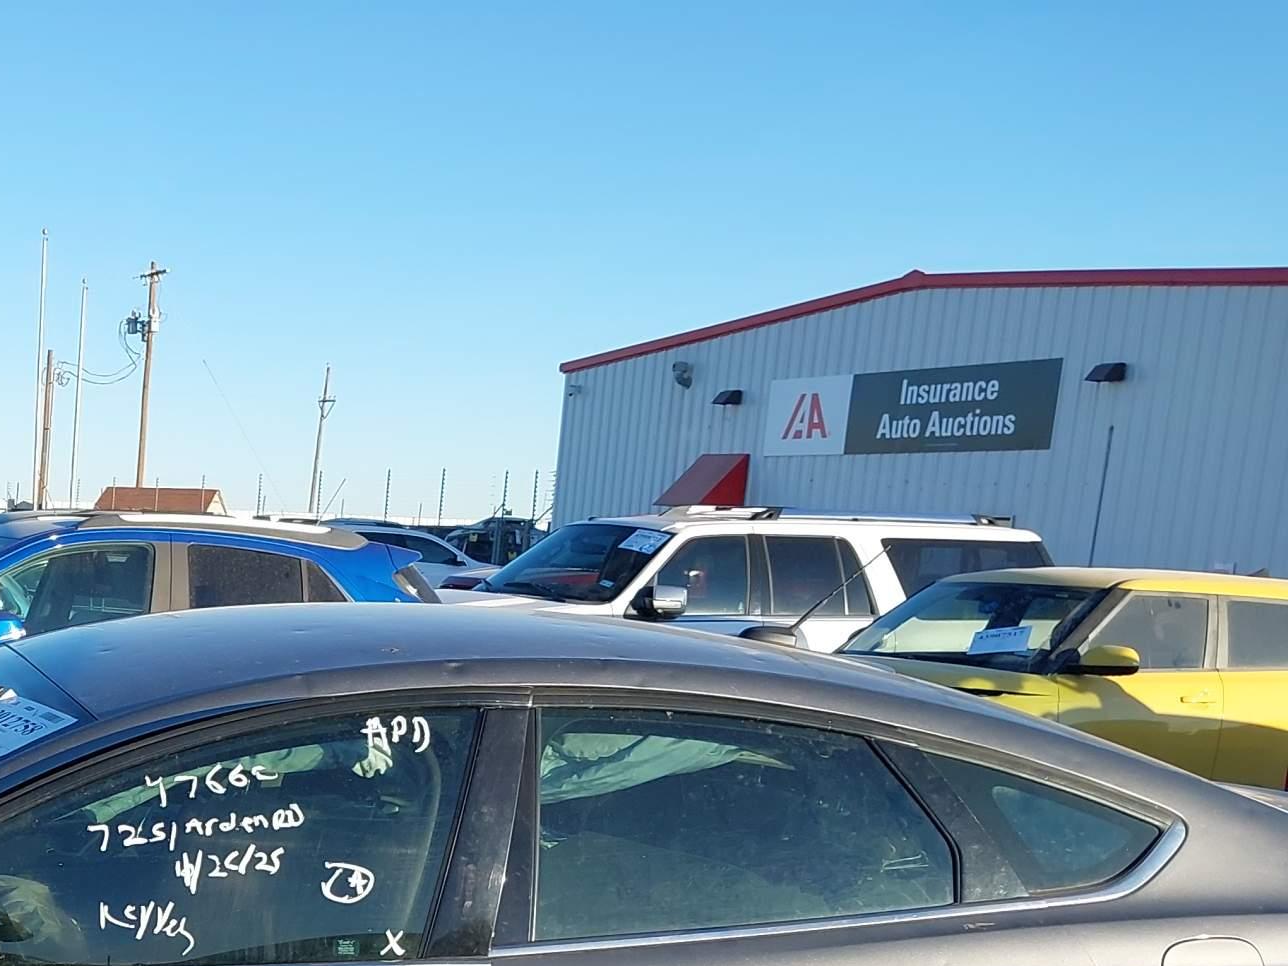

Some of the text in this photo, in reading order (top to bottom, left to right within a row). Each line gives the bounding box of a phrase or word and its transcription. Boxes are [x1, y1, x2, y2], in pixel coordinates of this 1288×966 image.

[900, 378, 1000, 405] Insurance
[876, 409, 1017, 440] Auto Auctions
[360, 715, 431, 756] APD
